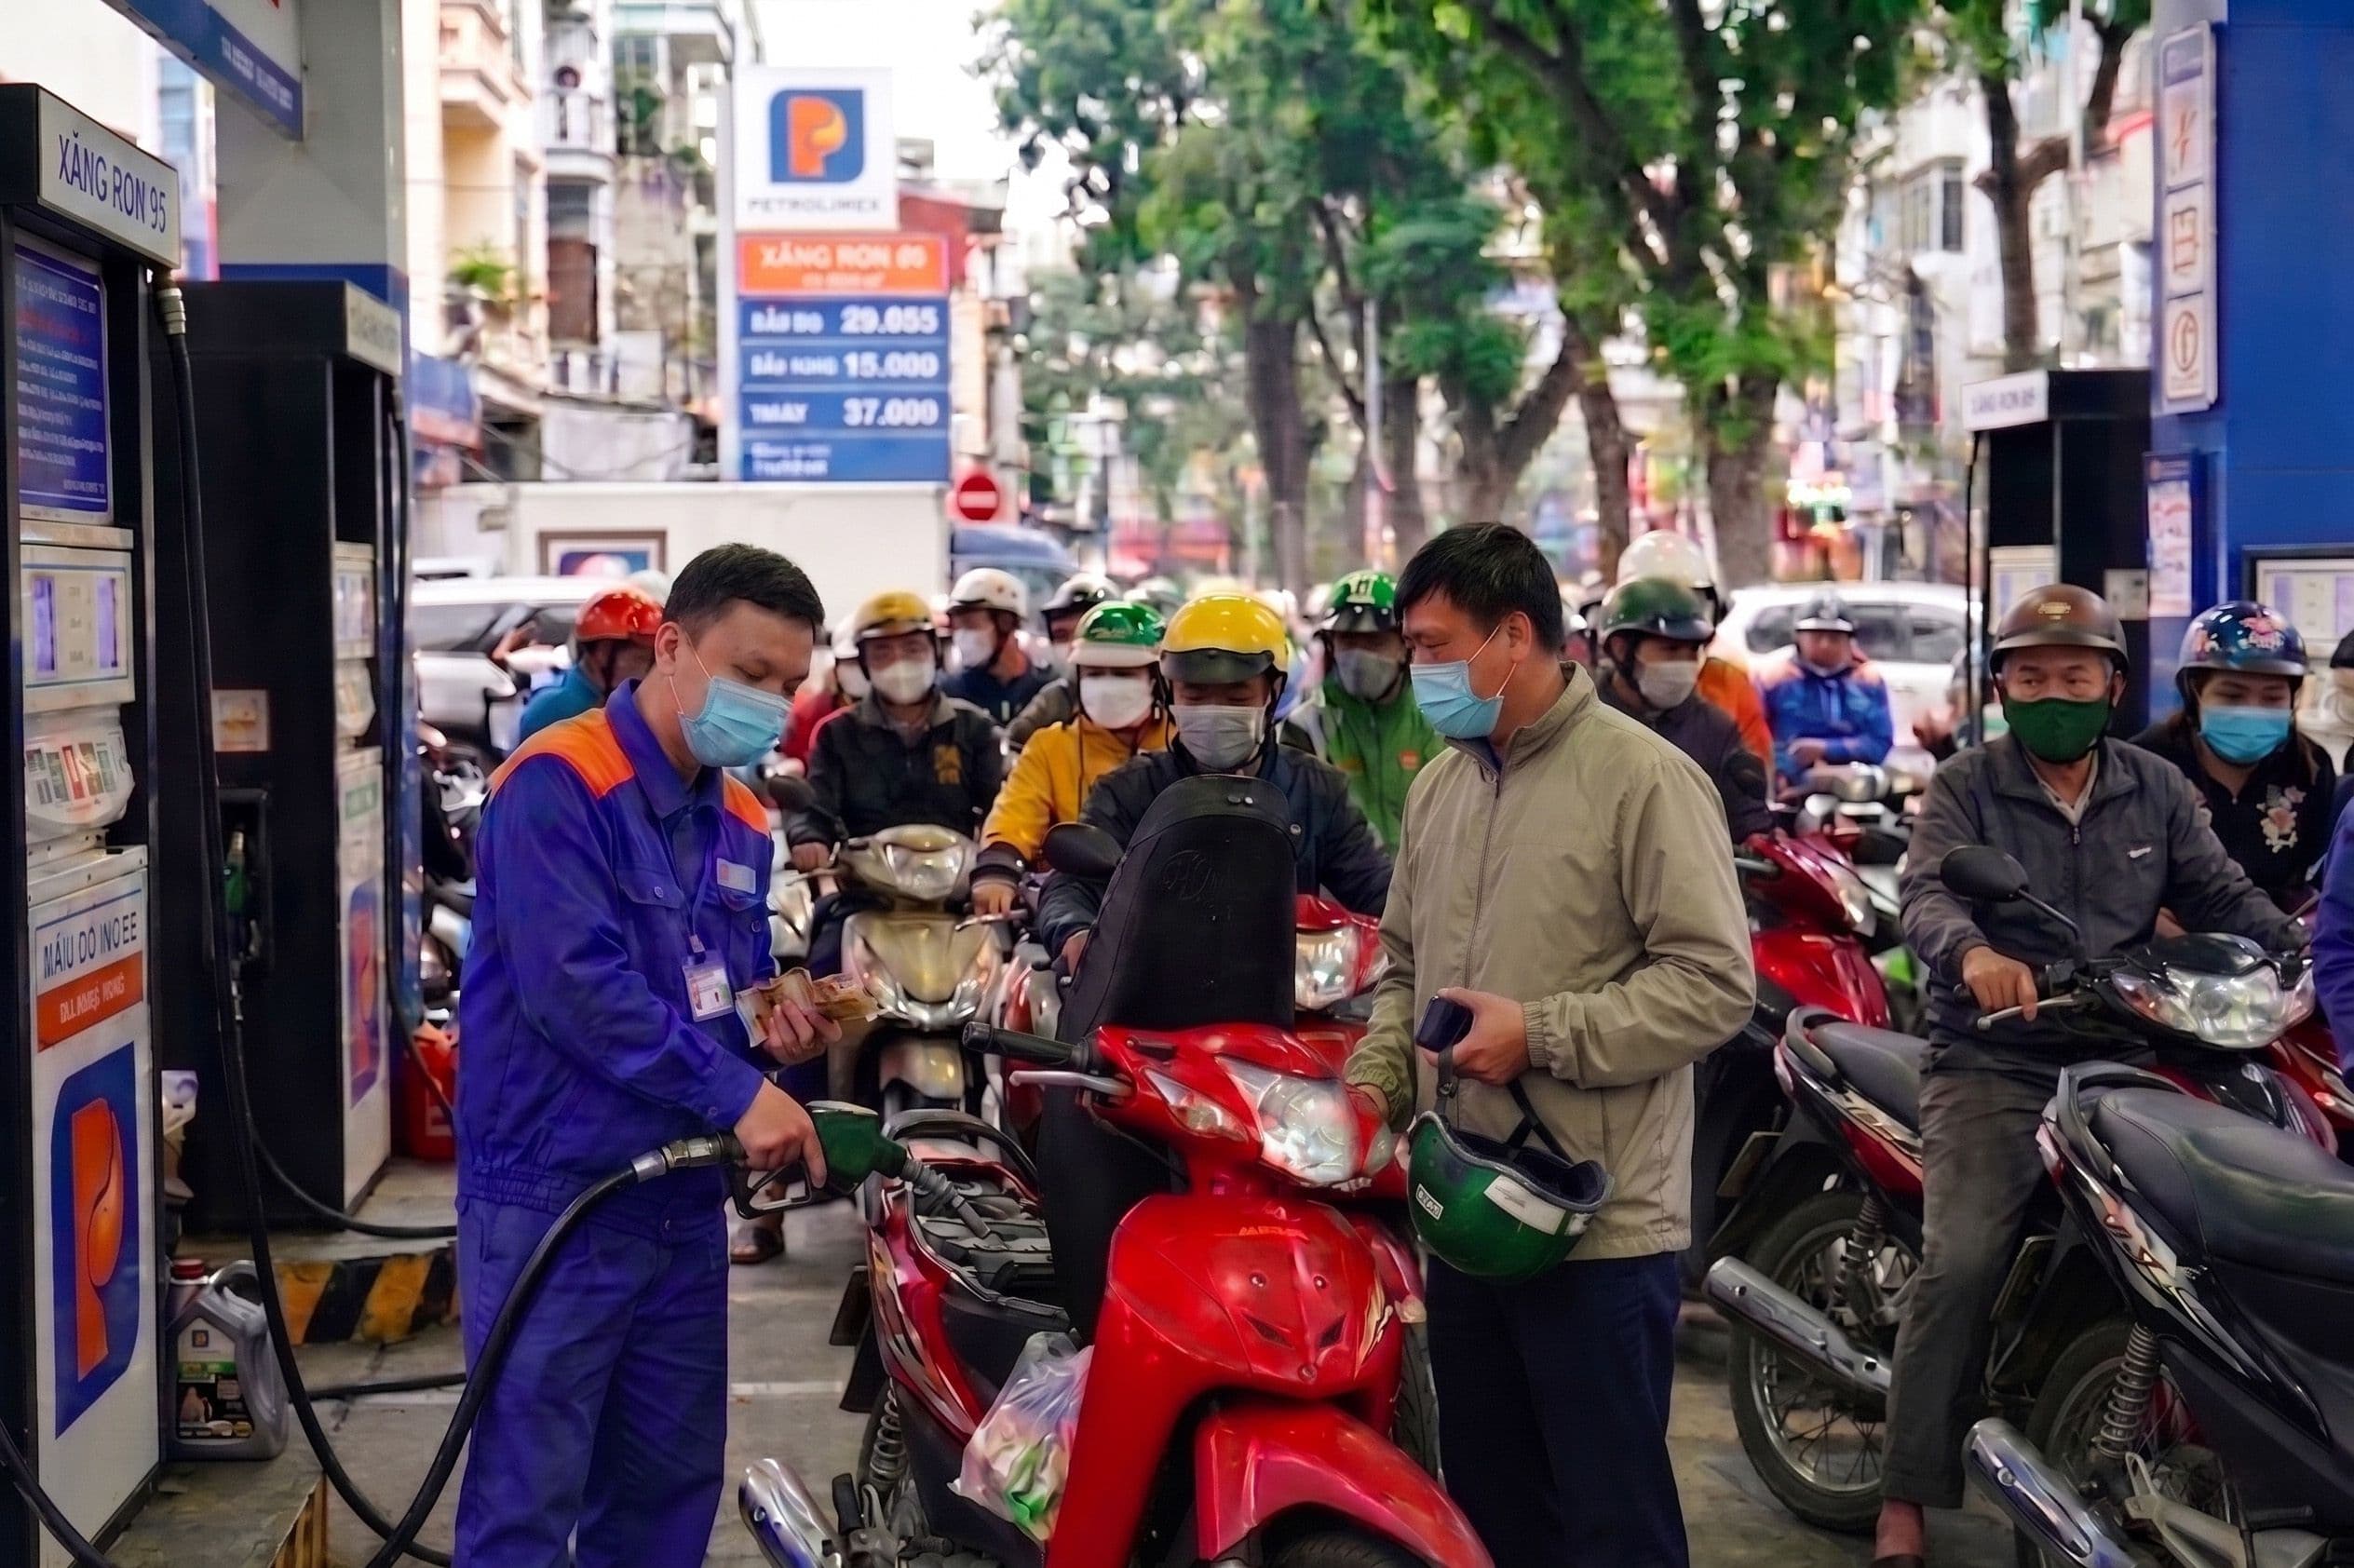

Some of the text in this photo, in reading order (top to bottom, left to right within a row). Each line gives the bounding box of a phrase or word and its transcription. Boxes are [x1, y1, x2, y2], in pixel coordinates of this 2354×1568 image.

[59, 129, 166, 233] XĂNG RON 95
[843, 398, 939, 426] 37.000
